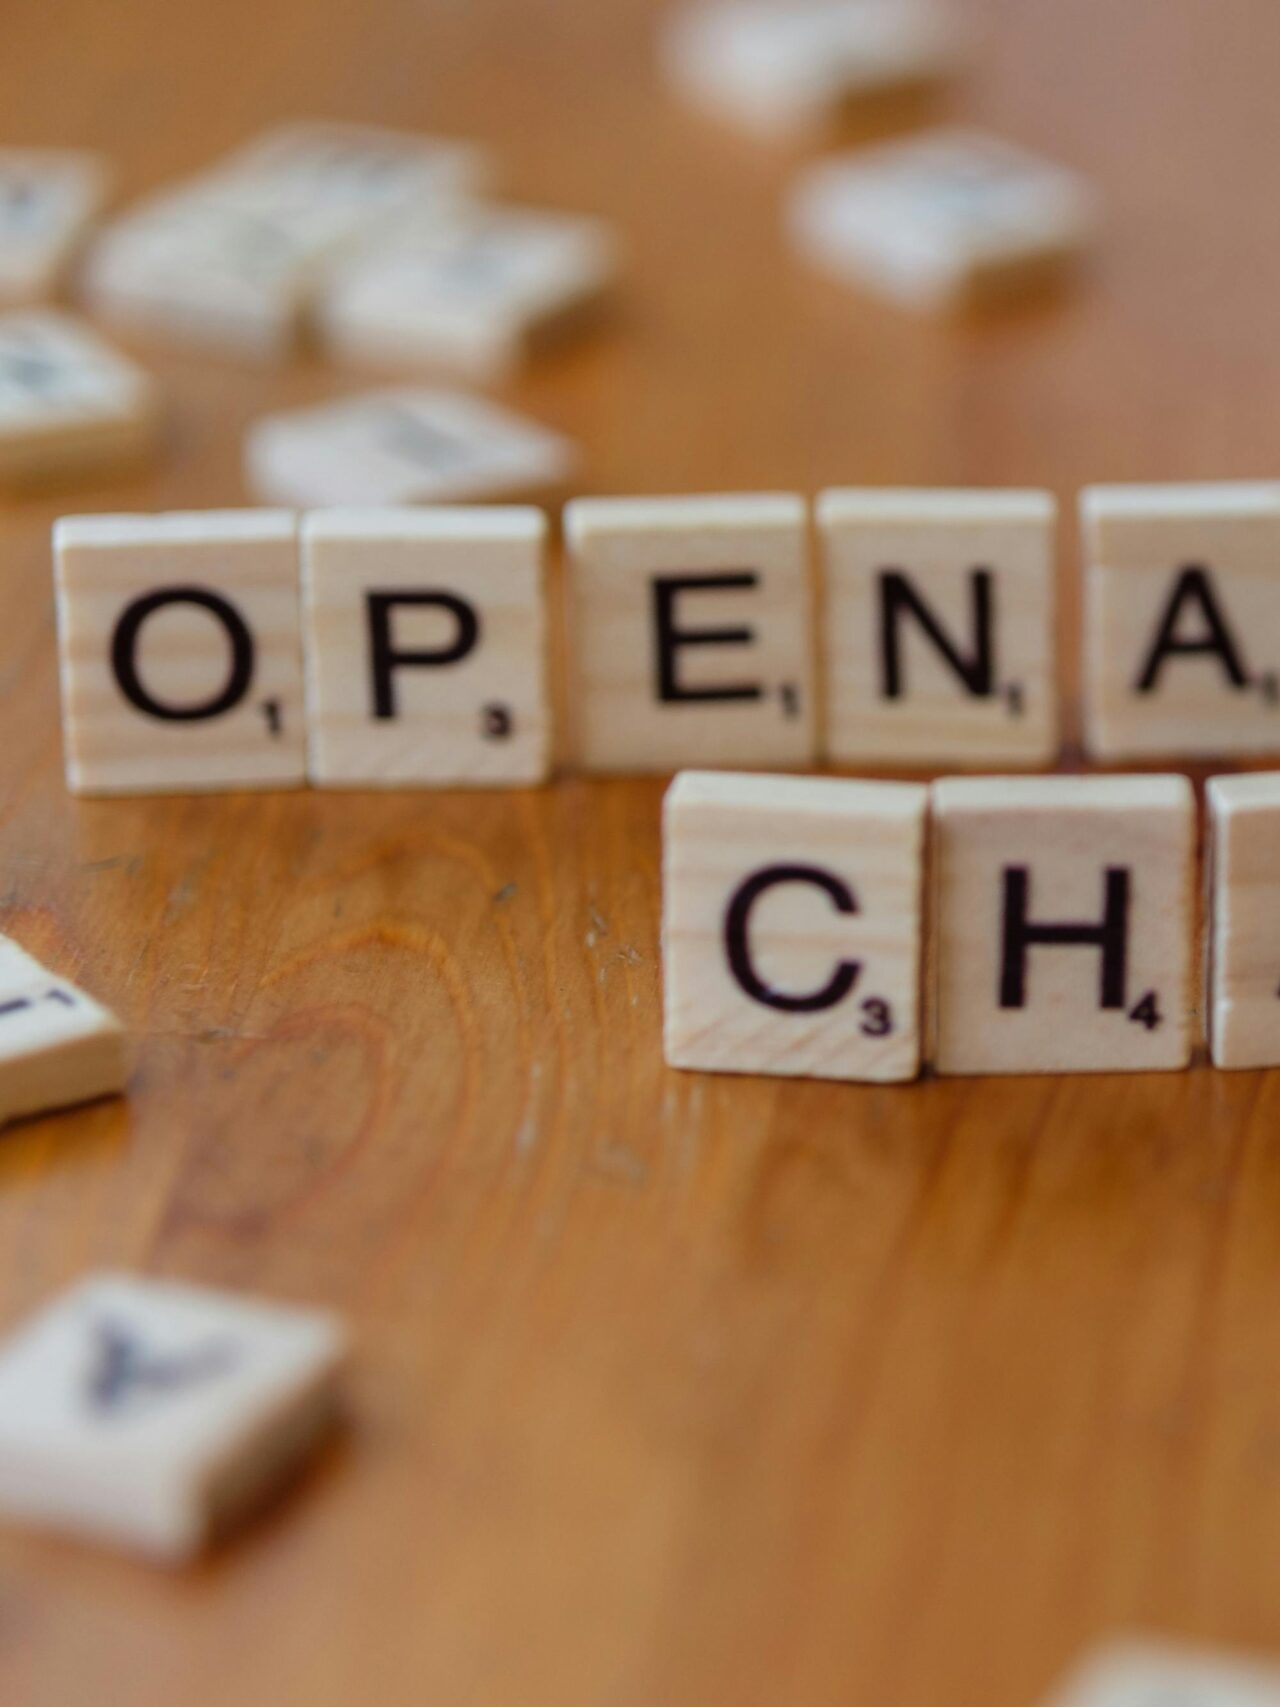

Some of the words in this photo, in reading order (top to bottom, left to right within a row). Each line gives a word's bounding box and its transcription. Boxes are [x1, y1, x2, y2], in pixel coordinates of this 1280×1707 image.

[263, 699, 282, 735] 1
[860, 998, 895, 1038] 3
[1129, 991, 1163, 1032] 4
